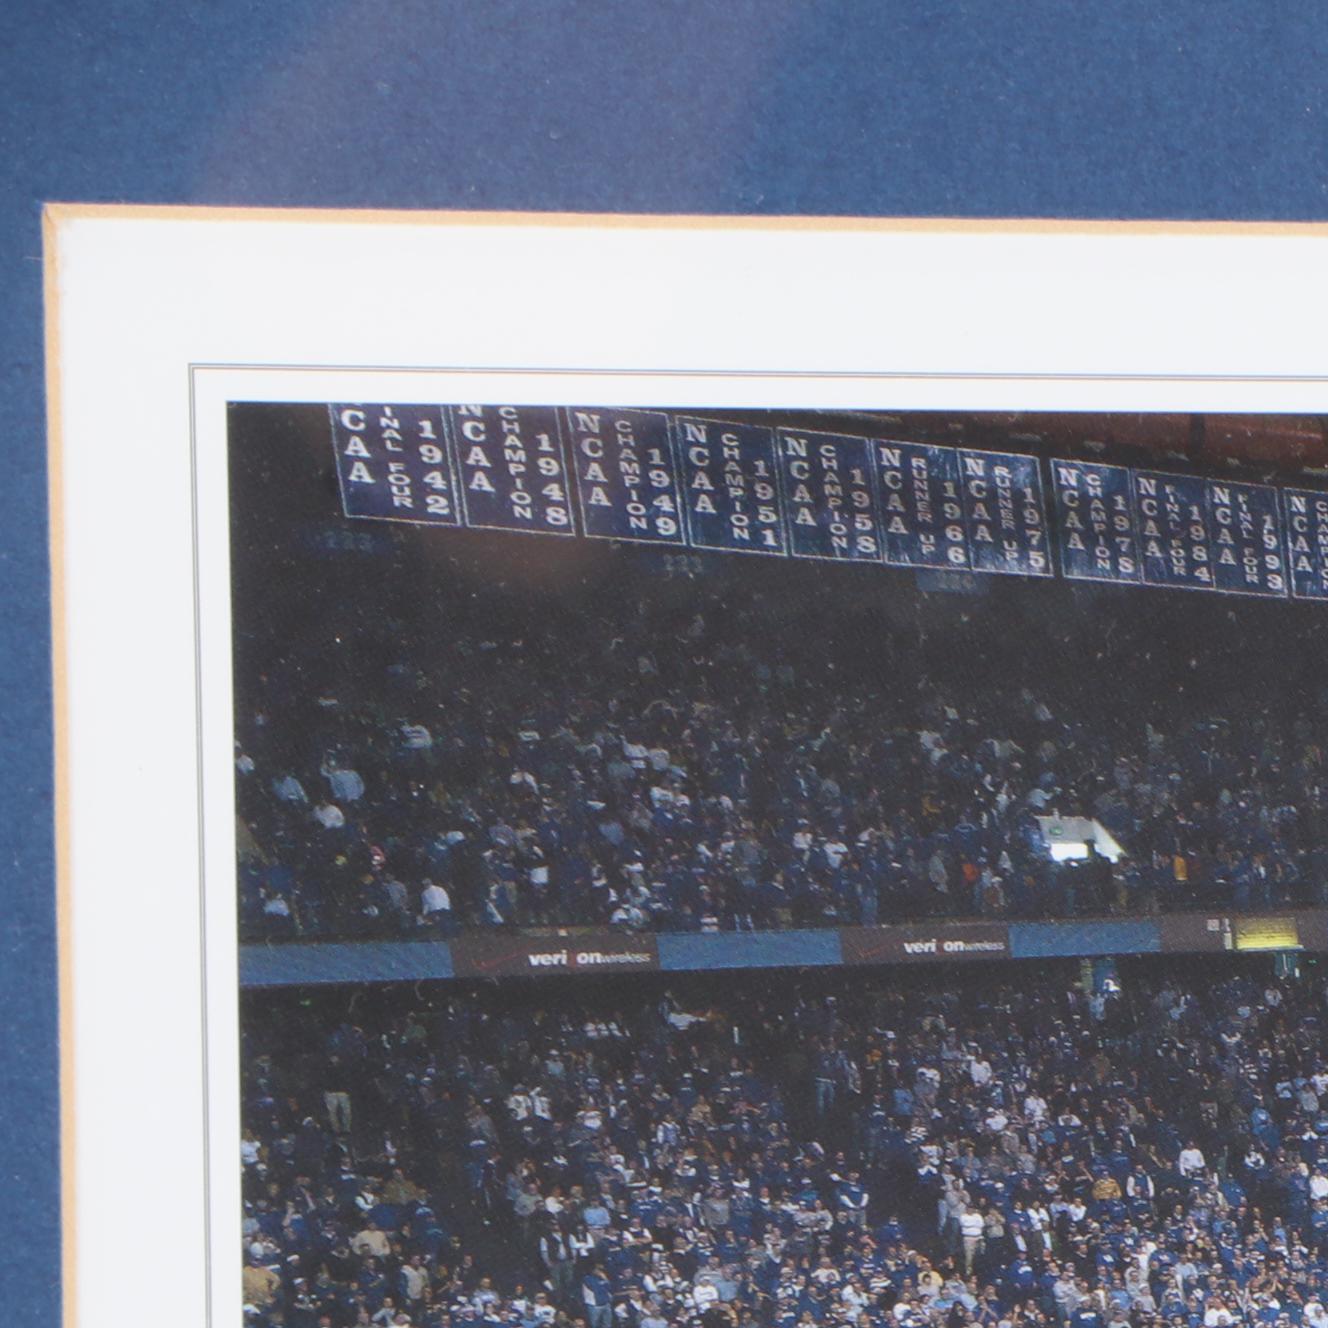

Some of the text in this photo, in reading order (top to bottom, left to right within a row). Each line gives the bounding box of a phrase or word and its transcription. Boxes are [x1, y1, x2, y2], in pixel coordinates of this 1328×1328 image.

[341, 404, 376, 484] CAA
[379, 404, 414, 509] INAL FOUR
[418, 420, 450, 515] 1942
[498, 406, 532, 520] CHAMPION
[536, 433, 569, 526] 1948
[575, 412, 613, 507] NCAA
[614, 420, 648, 530] CHAMPION
[683, 423, 718, 514] NCAA
[721, 433, 750, 541] CHAMPION
[784, 437, 817, 527] NCAA
[648, 447, 677, 536] 1949
[754, 460, 779, 547] 1951
[819, 445, 848, 549] CHAMPION
[850, 468, 877, 554] 1958
[879, 447, 909, 535] NCAA
[910, 457, 936, 555] RUNNER UP
[943, 481, 966, 564] 1966
[965, 457, 993, 543] NCAA
[1023, 487, 1045, 568] 1975
[1057, 467, 1086, 550] NCAA
[1086, 474, 1110, 571] CHAMPION
[1138, 477, 1164, 558] NCAA
[1213, 486, 1237, 566] NCAA
[1290, 496, 1313, 572] NCAA
[1189, 505, 1211, 582] 1984
